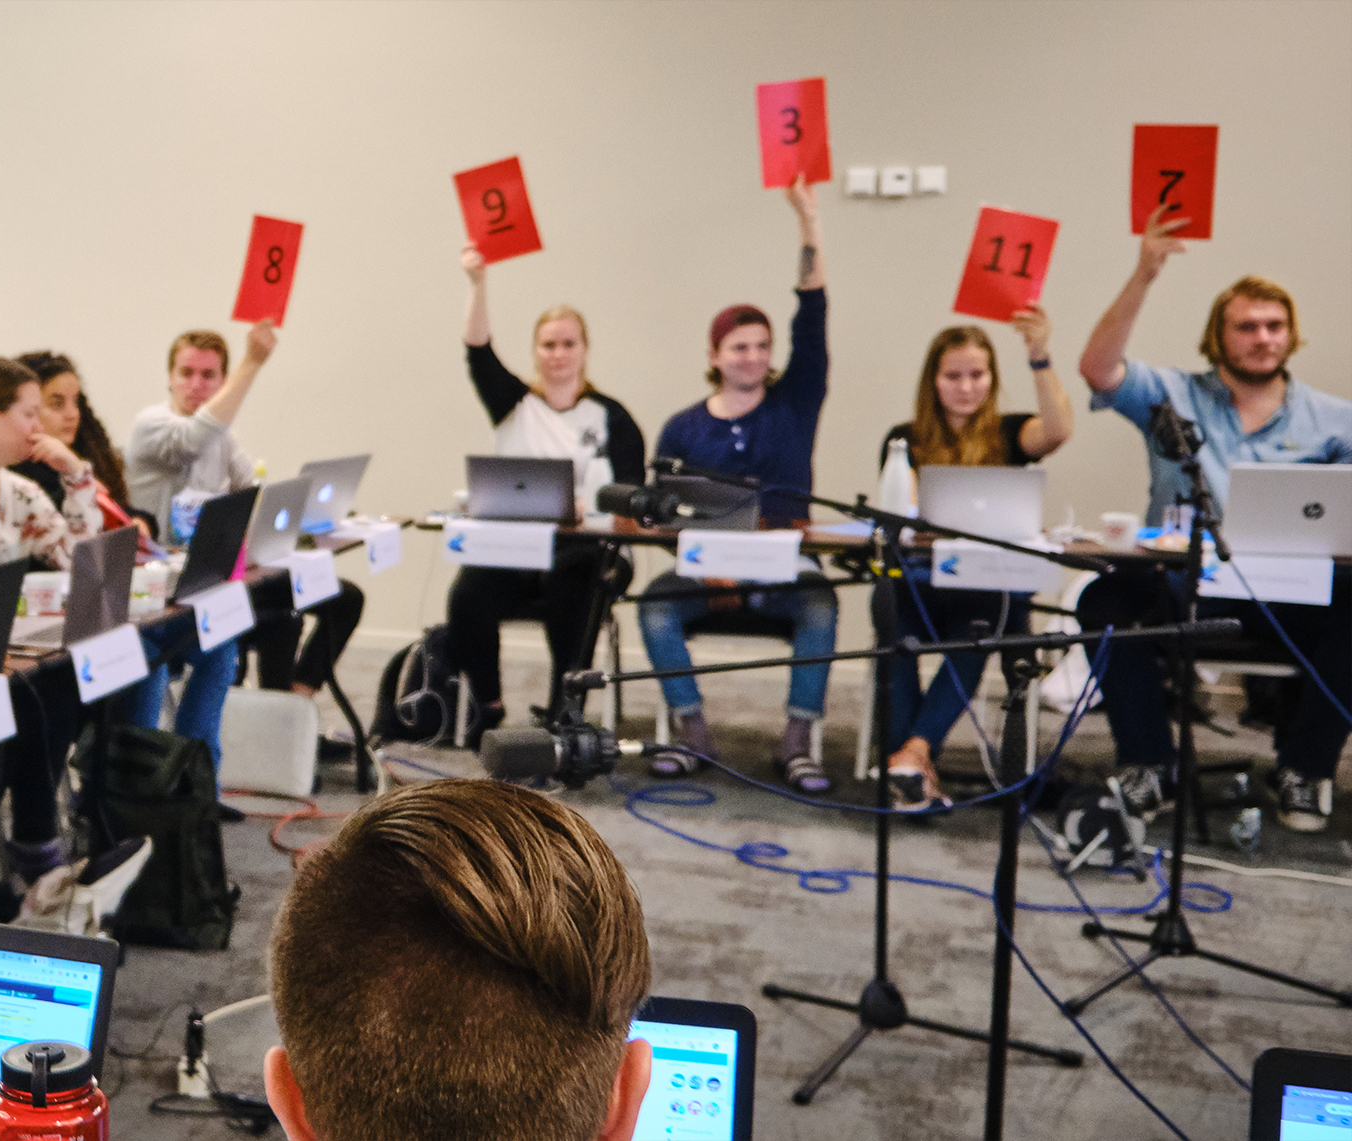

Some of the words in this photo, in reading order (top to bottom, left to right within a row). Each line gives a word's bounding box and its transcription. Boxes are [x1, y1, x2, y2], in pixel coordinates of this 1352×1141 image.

[782, 107, 803, 145] 3
[482, 188, 509, 229] 9
[264, 246, 283, 283] 8
[982, 236, 1033, 279] 11
